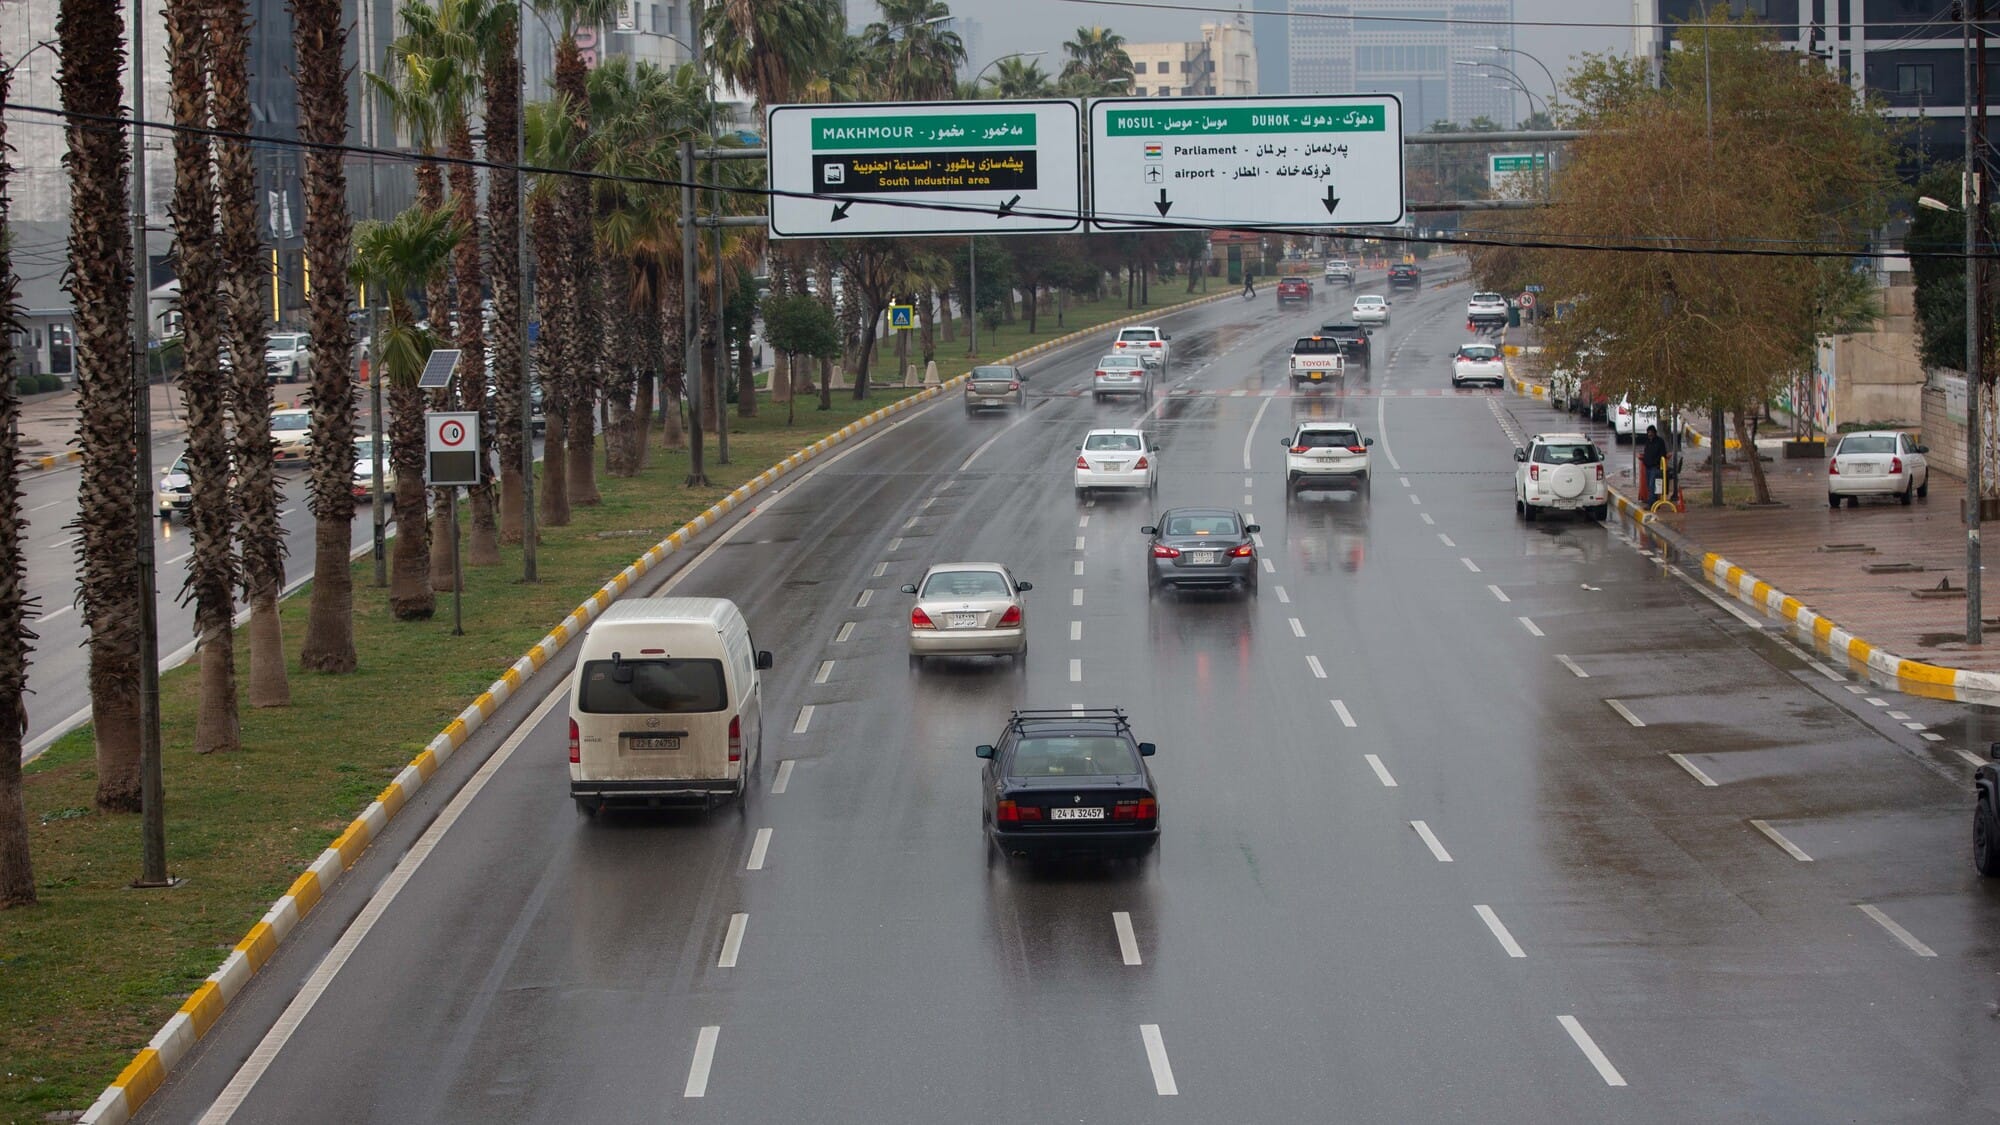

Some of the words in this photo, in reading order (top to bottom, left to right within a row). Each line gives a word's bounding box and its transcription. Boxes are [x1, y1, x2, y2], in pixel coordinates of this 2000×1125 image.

[1117, 116, 1155, 129] MOSUL
[1163, 117, 1193, 131] موصل
[1252, 114, 1290, 127] DUHOK
[822, 126, 914, 140] MAKHMOUR
[928, 124, 965, 141] مخمور
[1174, 145, 1237, 156] Parliament
[1256, 143, 1287, 158] برلمان
[852, 159, 892, 175] الجنوبية
[894, 159, 932, 171] الصناعة
[1174, 168, 1215, 180] airport
[1232, 166, 1260, 180] المطار
[879, 176, 910, 187] South
[914, 175, 964, 186] industrial
[967, 177, 990, 185] area
[1057, 809, 1067, 818] 24
[1077, 808, 1101, 817] 32457
